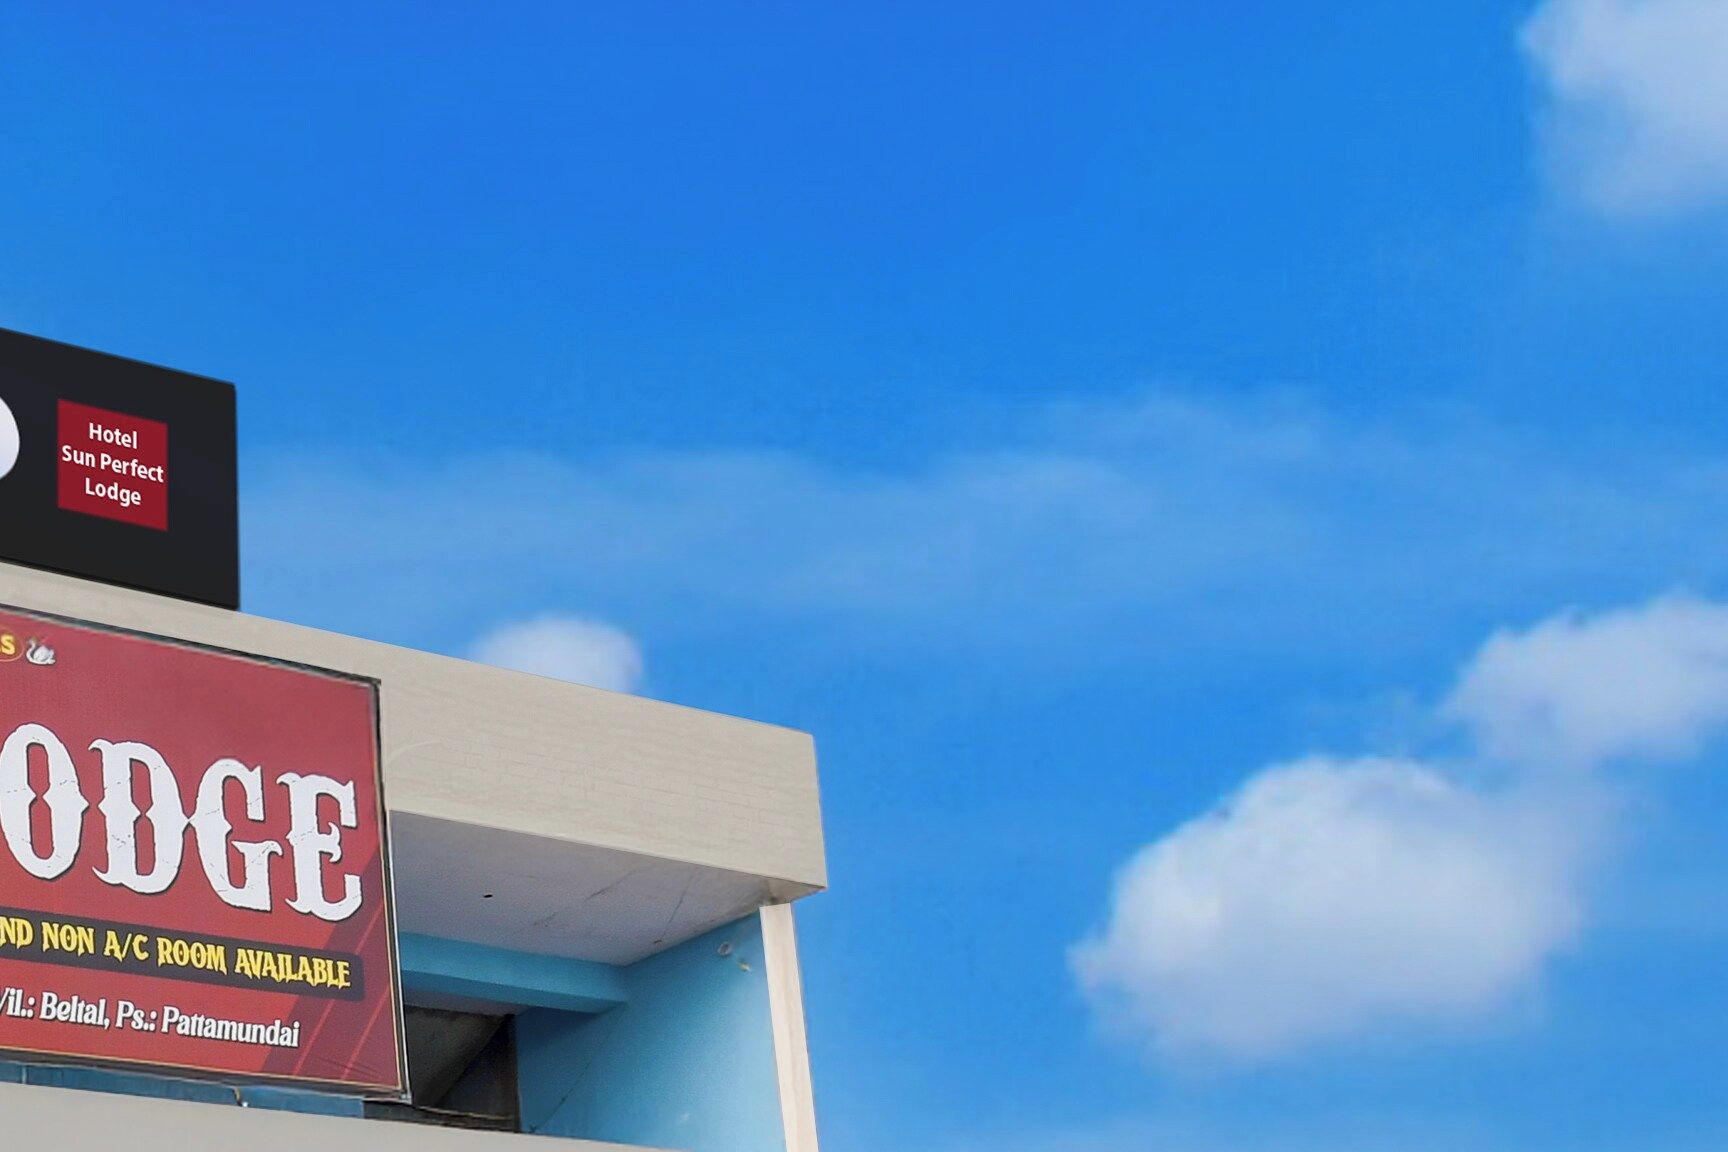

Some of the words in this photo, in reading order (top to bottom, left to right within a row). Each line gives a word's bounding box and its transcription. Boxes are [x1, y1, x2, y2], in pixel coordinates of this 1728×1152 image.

[88, 421, 139, 451] Hotel
[61, 444, 97, 469] Sun
[100, 452, 165, 484] Perfect
[84, 476, 143, 508] Lodge
[41, 921, 96, 957] NON
[104, 930, 150, 963] A/C
[156, 936, 228, 975] ROOM
[234, 949, 352, 990] AVAILABLE
[40, 992, 110, 1029] Beltal,
[115, 1000, 158, 1032] Ps.:
[161, 1005, 301, 1048] Pattamundai
